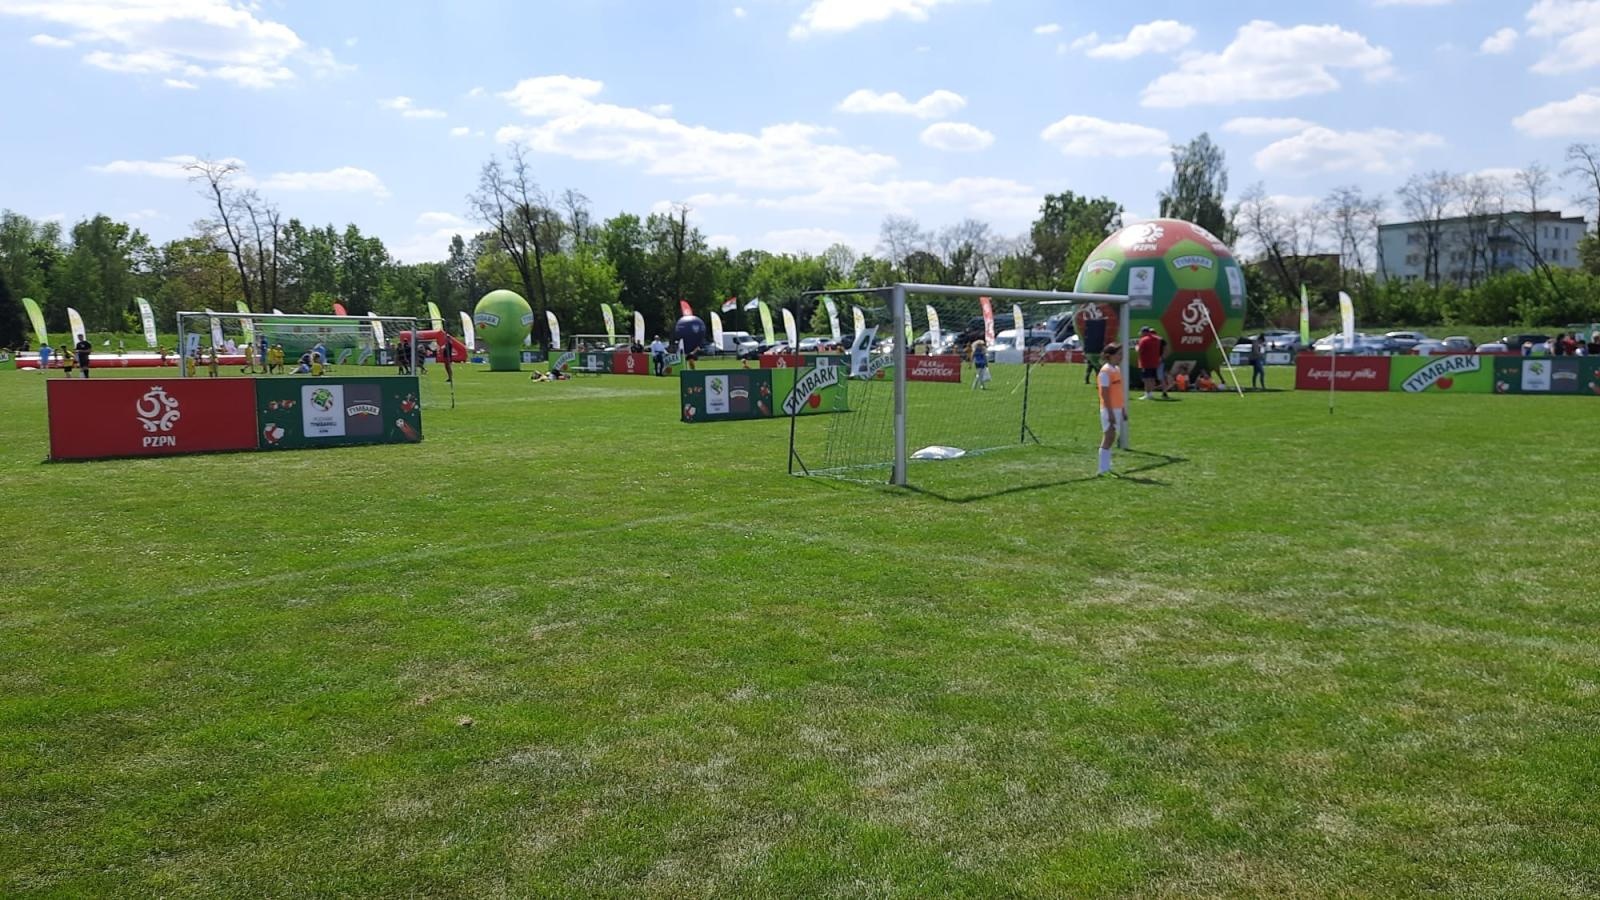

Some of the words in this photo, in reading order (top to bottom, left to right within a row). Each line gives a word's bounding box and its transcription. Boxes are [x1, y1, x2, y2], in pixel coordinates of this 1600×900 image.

[1181, 336, 1203, 344] PZPN
[1407, 355, 1475, 392] TYMBARK
[786, 366, 836, 409] TYMBARK
[143, 435, 176, 448] PZPN
